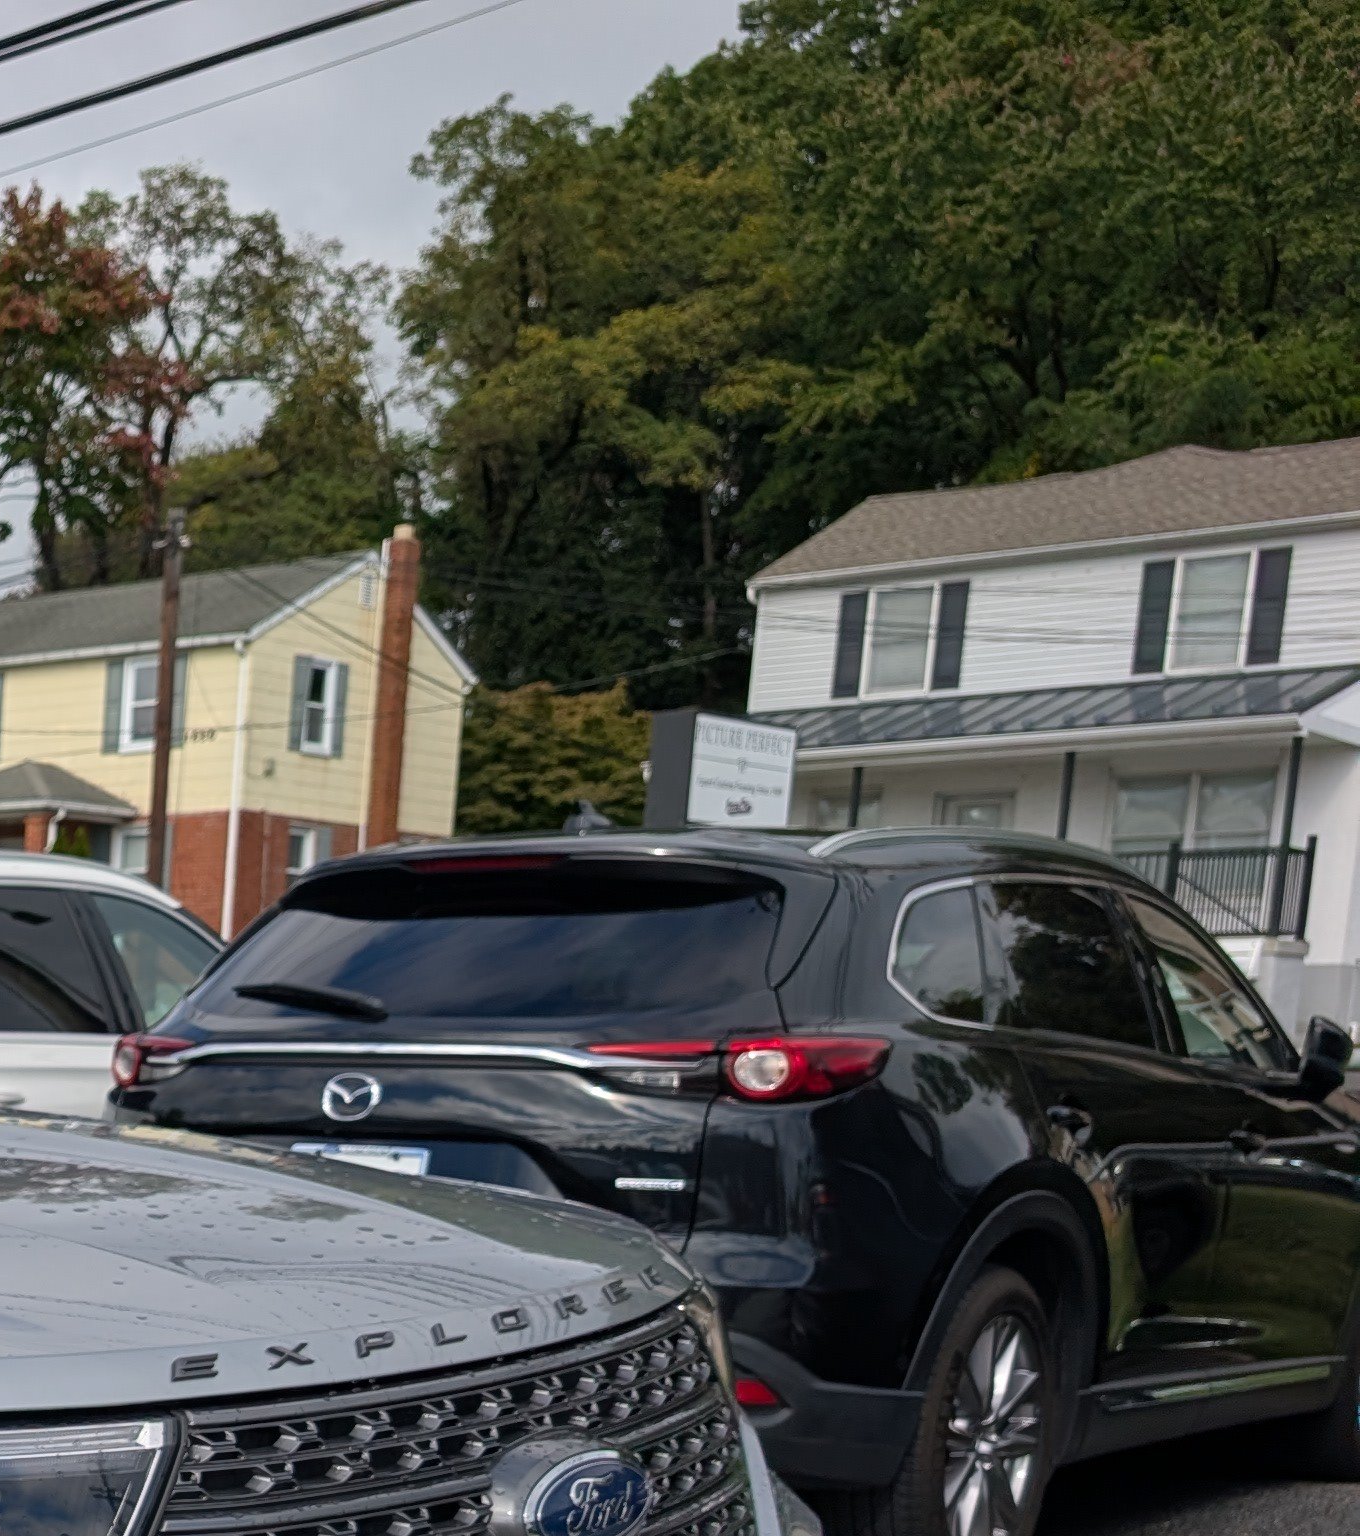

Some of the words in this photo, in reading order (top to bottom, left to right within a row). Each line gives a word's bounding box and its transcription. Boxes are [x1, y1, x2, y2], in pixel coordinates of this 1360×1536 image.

[695, 721, 743, 749] PICTURE
[745, 729, 792, 758] PERFECT
[169, 1265, 664, 1383] EXPLORER
